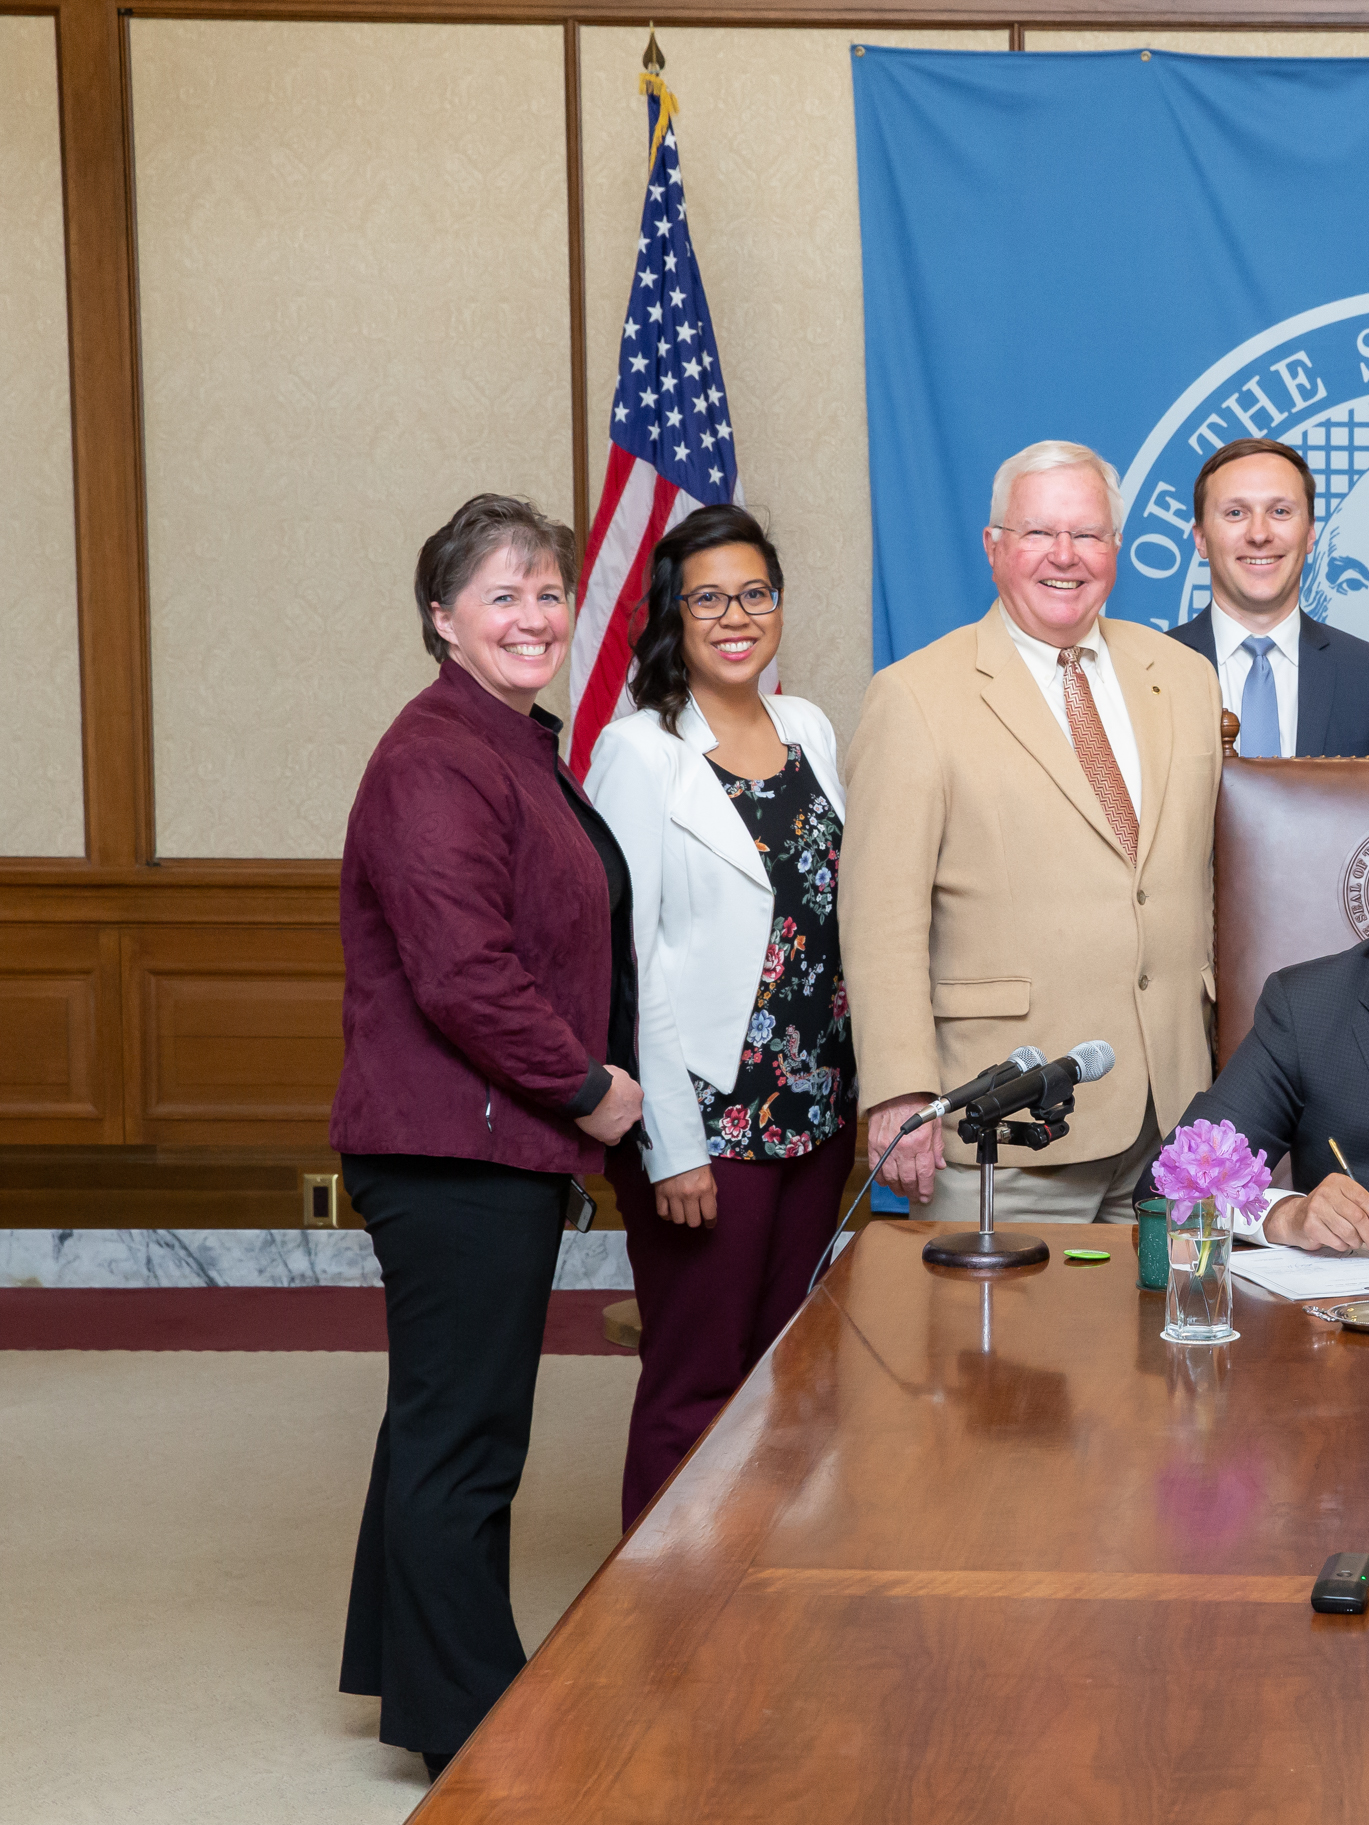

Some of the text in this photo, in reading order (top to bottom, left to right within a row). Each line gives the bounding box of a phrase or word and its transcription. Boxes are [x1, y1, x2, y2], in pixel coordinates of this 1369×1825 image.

[1130, 481, 1195, 579] OF
[1188, 350, 1328, 455] THE
[1352, 858, 1369, 879] OF
[1349, 883, 1368, 924] SEAL
